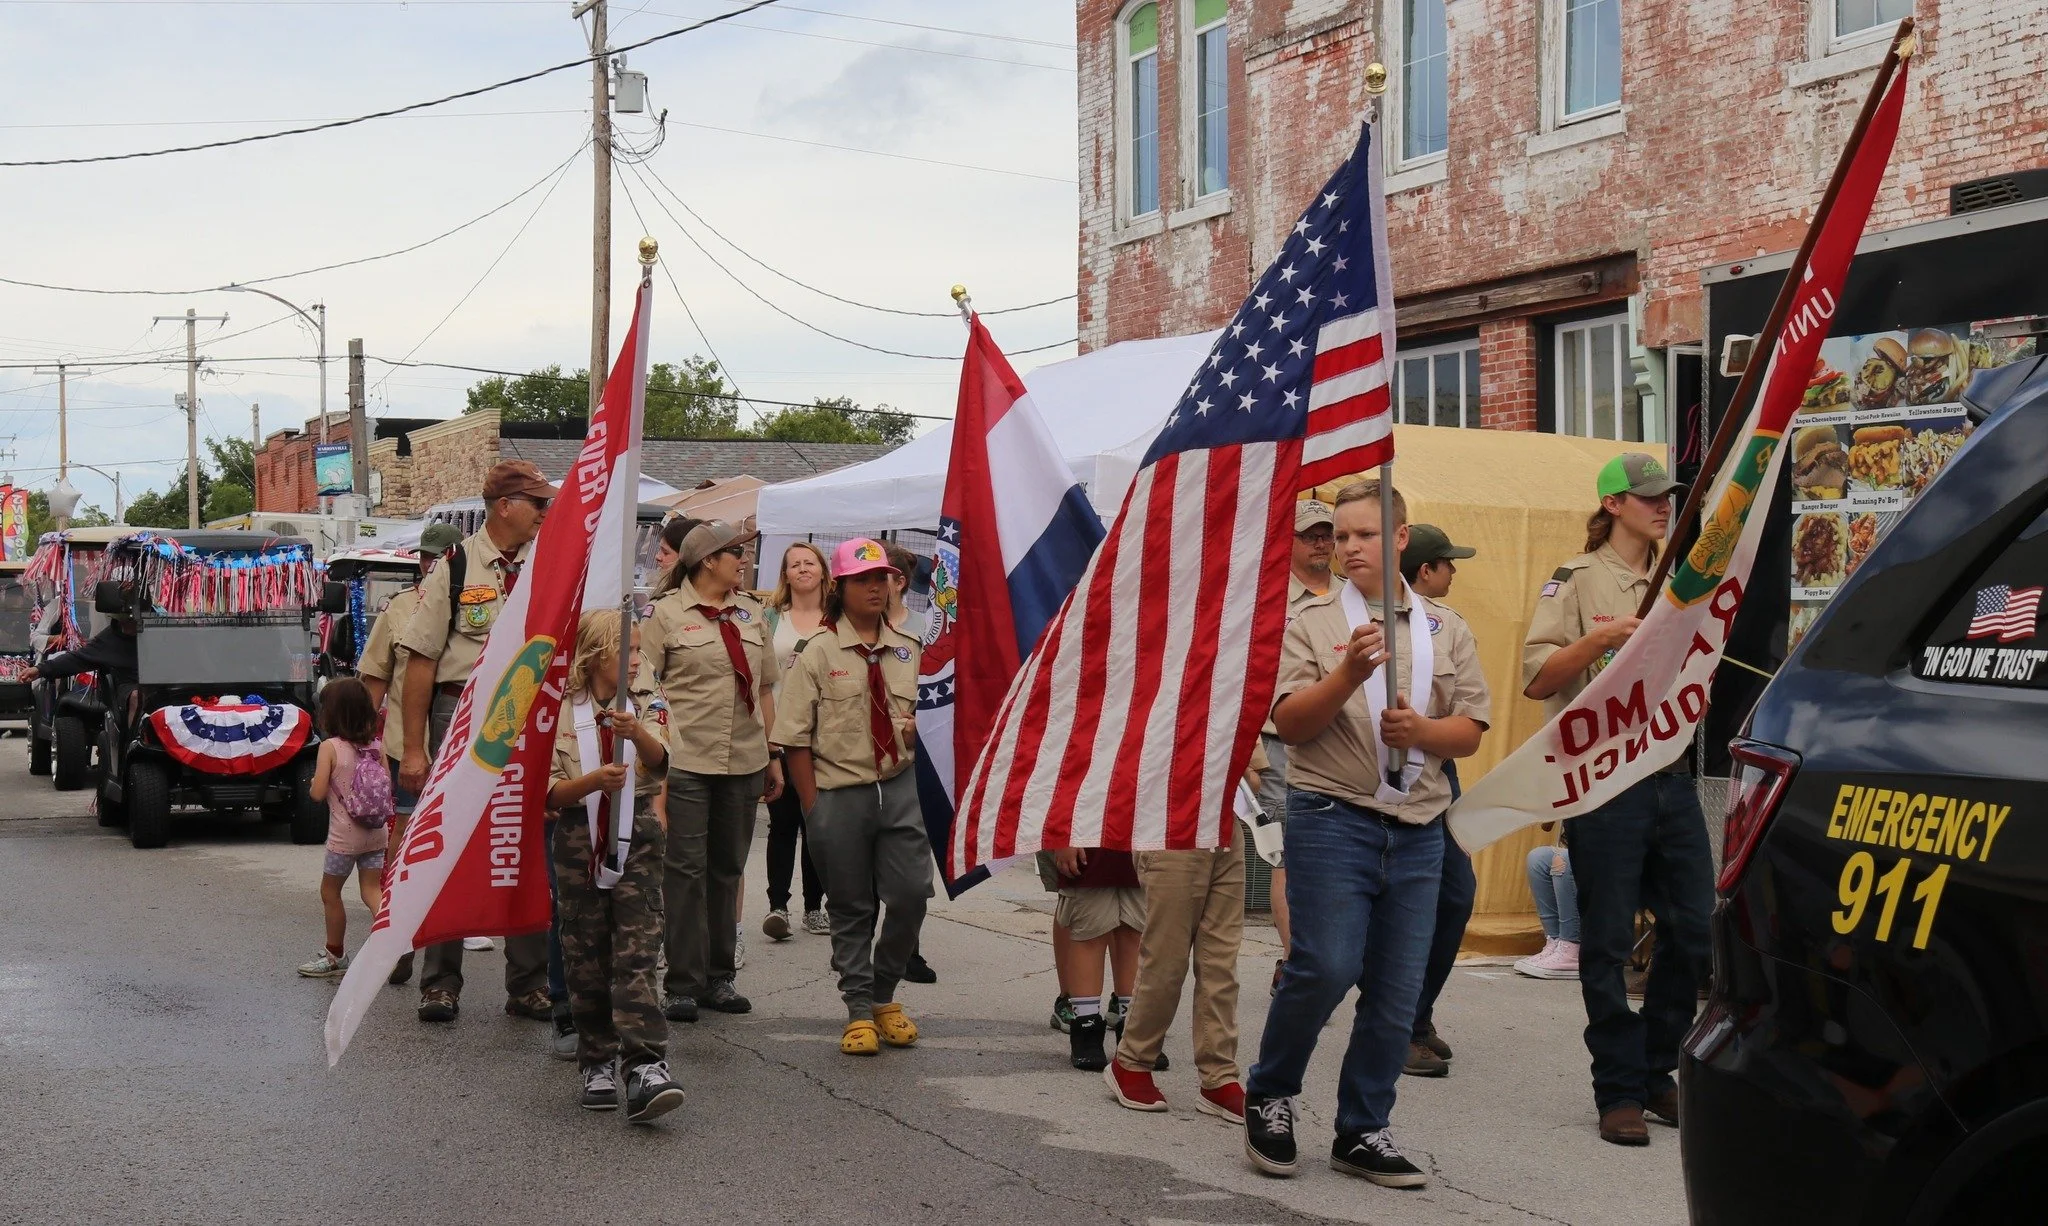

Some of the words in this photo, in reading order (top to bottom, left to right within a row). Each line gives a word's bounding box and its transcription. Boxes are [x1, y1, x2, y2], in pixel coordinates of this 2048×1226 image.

[1908, 408, 1942, 416] Yellowstone
[1942, 406, 1963, 415] Burger
[1811, 414, 1847, 423] Cheeseburger
[1852, 497, 1878, 506] Amazing
[1887, 496, 1899, 505] Boy
[1801, 503, 1819, 511] Ranger
[1820, 502, 1839, 510] Burger
[1804, 589, 1818, 597] Piggy
[1601, 615, 1615, 623] BSA
[1921, 646, 1945, 676] "IN
[1940, 646, 1973, 678] GOD
[1968, 647, 1996, 679] WE
[1991, 648, 2048, 681] TRUST"
[490, 762, 525, 888] CHURCH
[1826, 783, 2012, 863] EMERGENCY
[1831, 851, 1951, 950] 911
